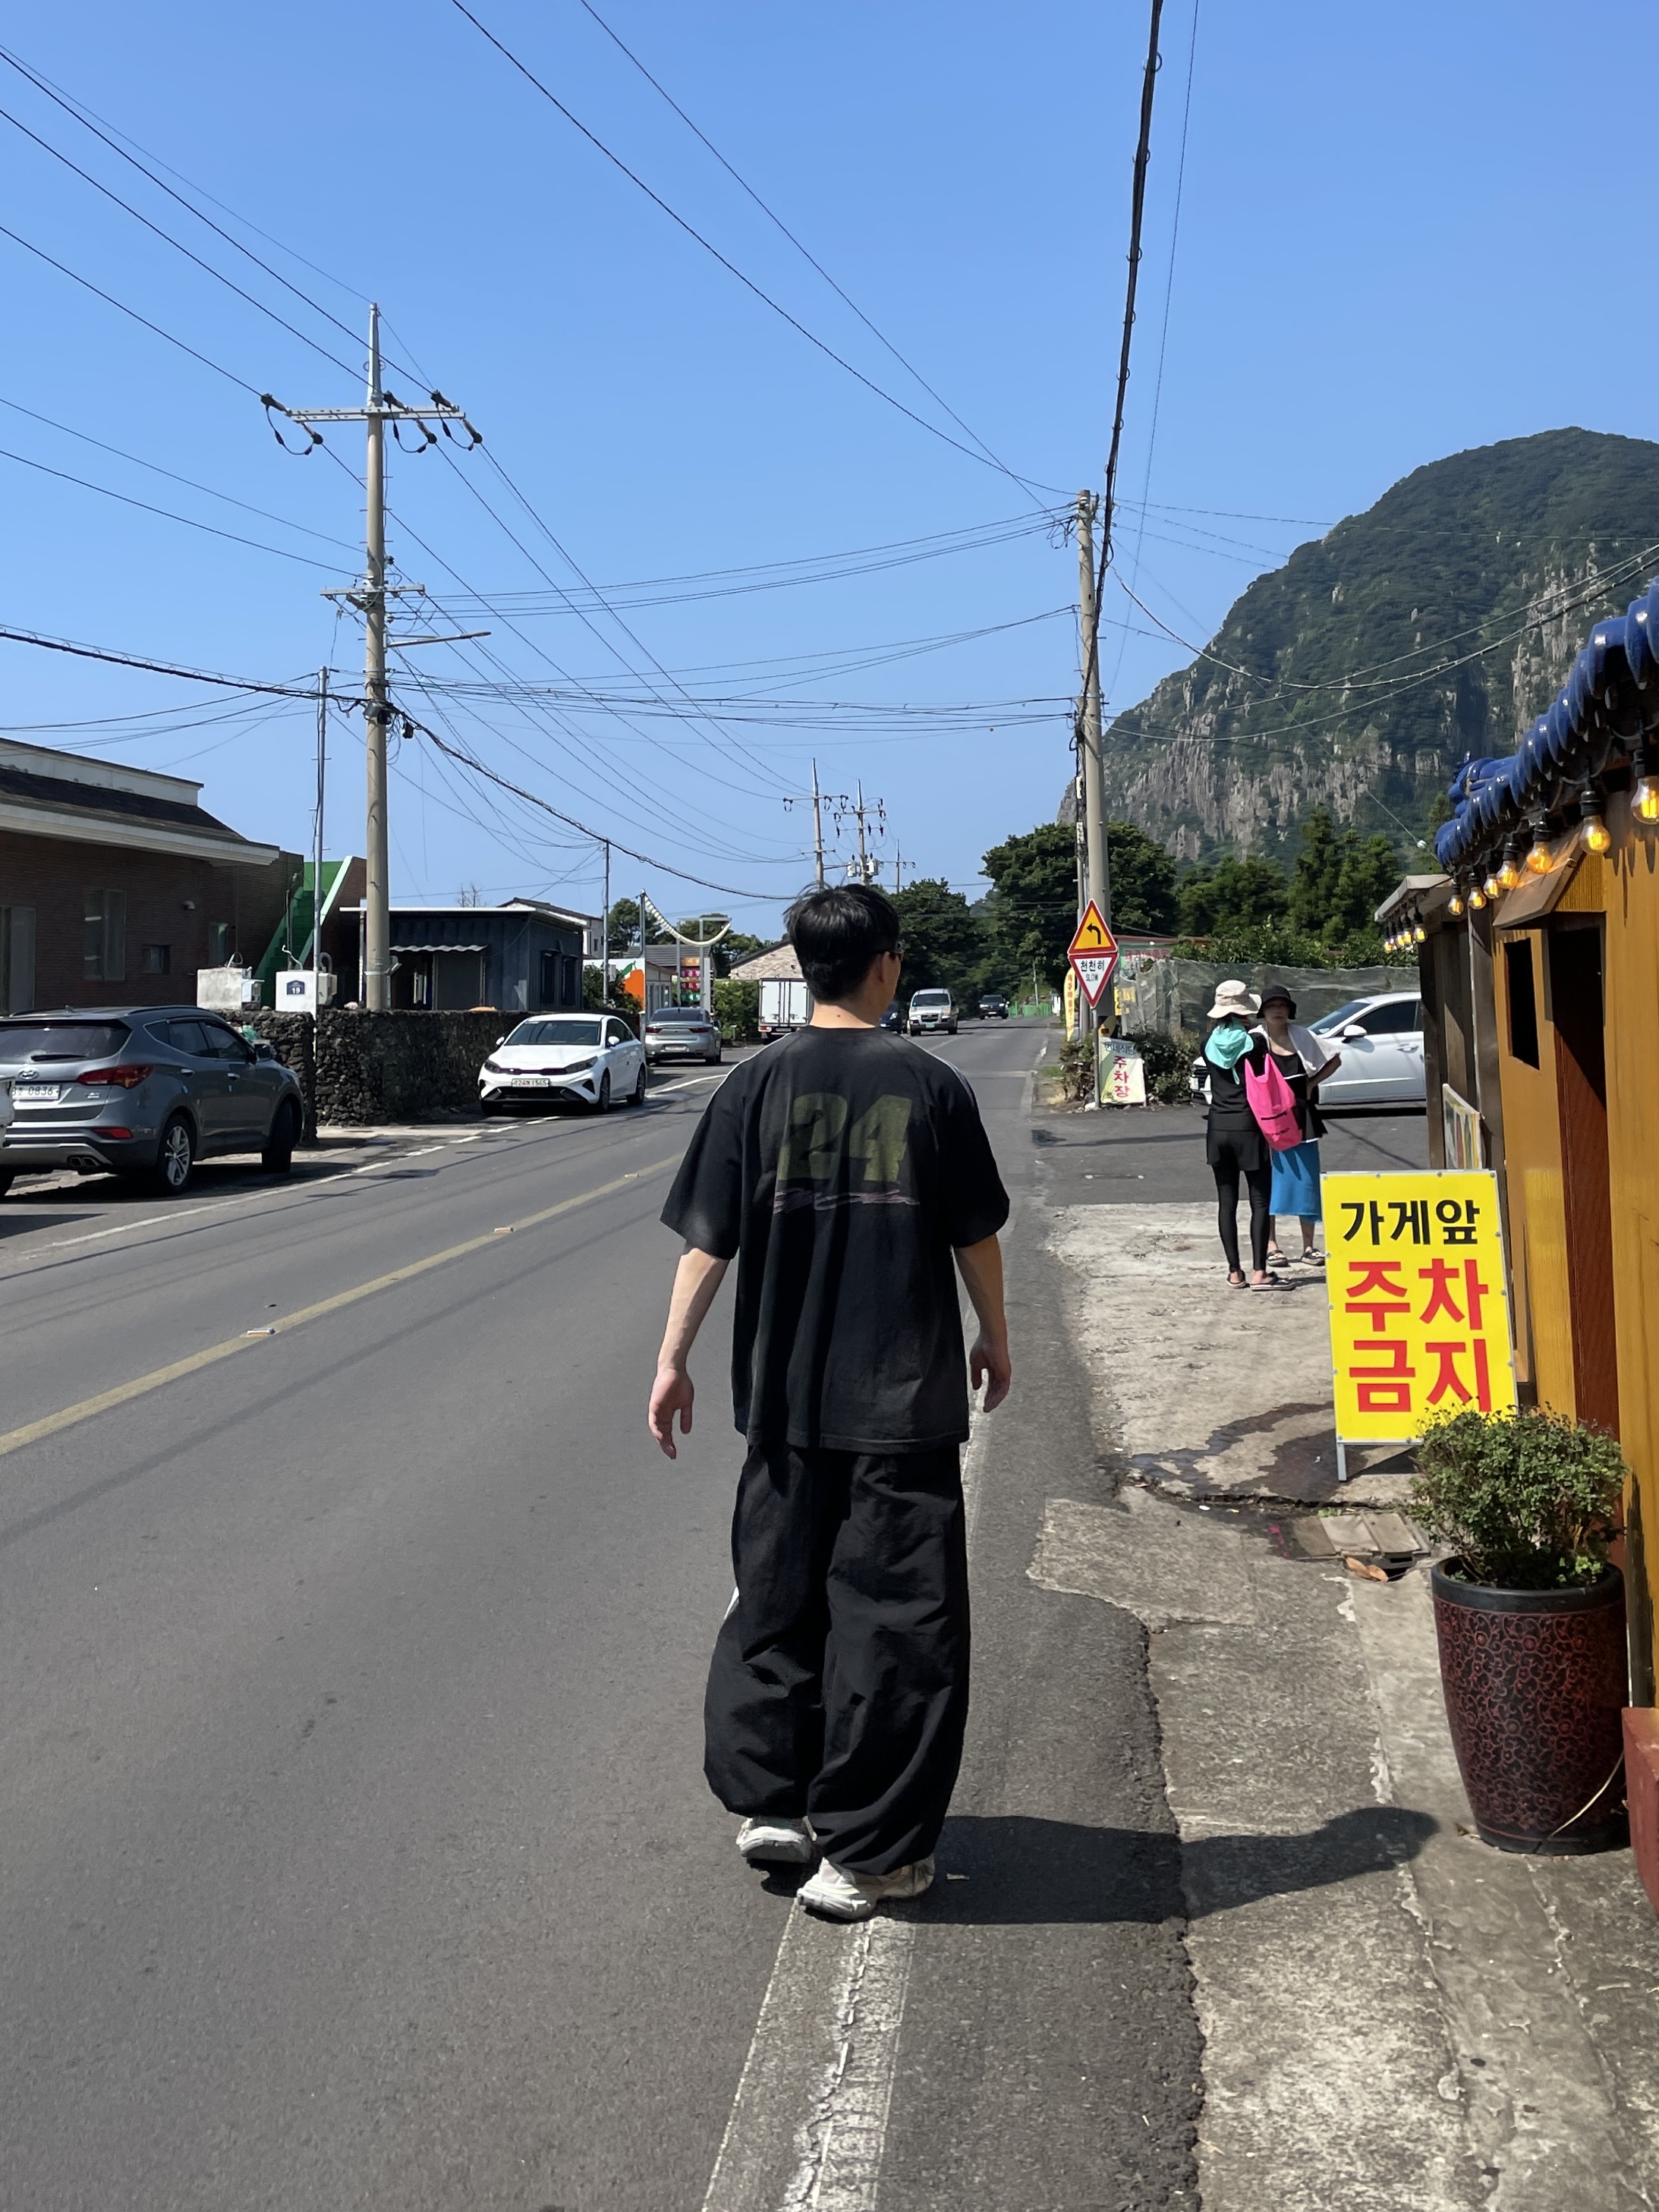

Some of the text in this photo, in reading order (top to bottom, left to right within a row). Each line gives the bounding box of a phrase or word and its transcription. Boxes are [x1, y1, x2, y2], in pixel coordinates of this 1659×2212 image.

[1080, 960, 1104, 972] 천천히
[28, 1086, 53, 1096] 0836
[1113, 1056, 1129, 1098] 주차장
[777, 1092, 912, 1182] 24
[1340, 1199, 1480, 1245] 가게앞
[1345, 1258, 1489, 1332] 주차
[1349, 1339, 1492, 1413] 금지
